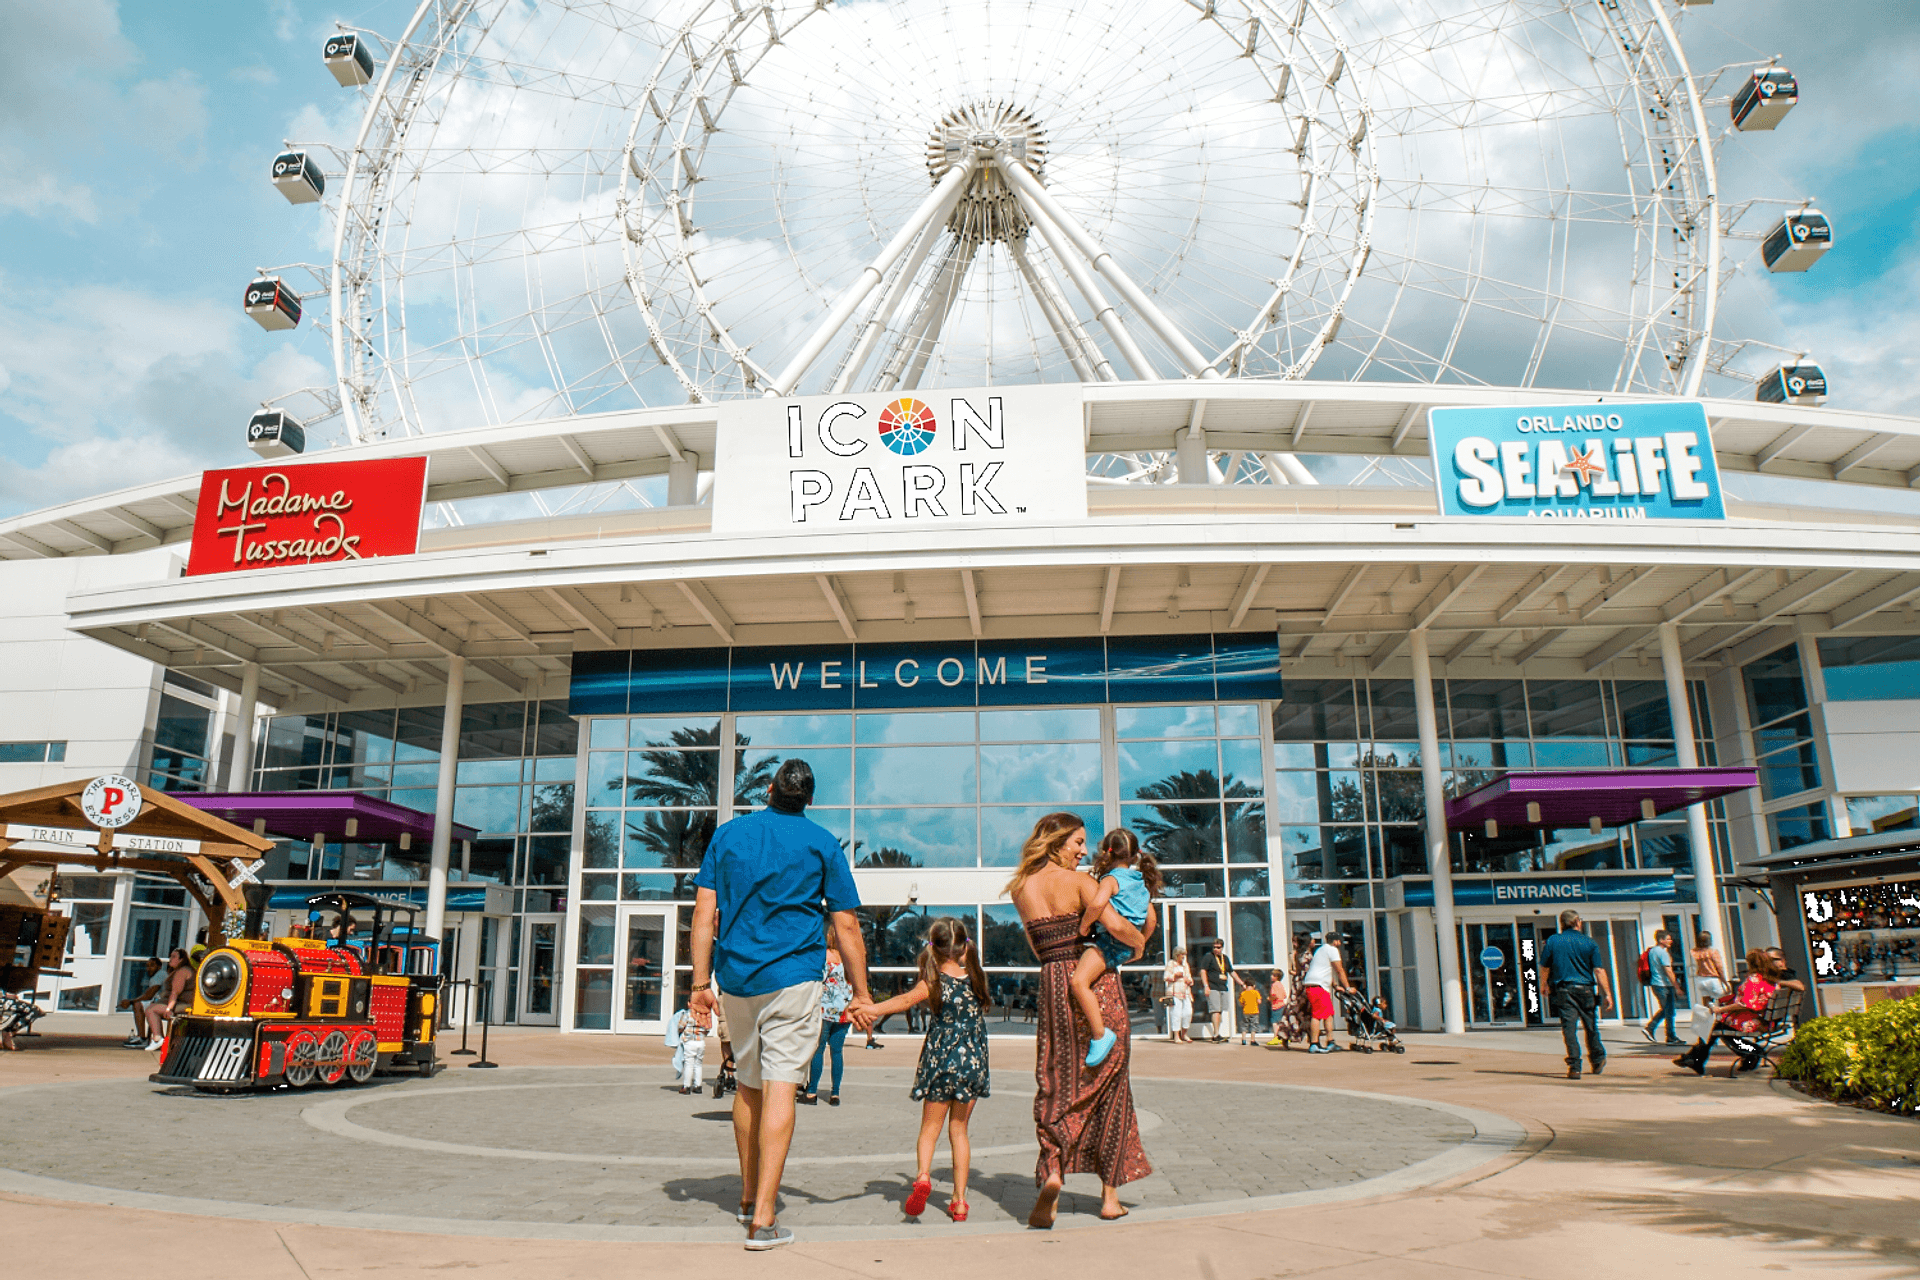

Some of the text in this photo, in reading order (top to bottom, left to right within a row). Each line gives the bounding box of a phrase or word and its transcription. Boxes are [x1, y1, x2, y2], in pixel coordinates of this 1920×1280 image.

[1516, 413, 1624, 433] ORLANDO
[1454, 435, 1580, 507] SEA
[217, 473, 353, 521] Madame
[790, 461, 1008, 523] PARK
[217, 513, 363, 564] Tussauds
[770, 655, 1048, 690] WELCOME
[86, 776, 139, 801] THE PEARL
[101, 786, 124, 815] P
[85, 804, 136, 826] EXPRESS
[31, 828, 184, 850] TRAIN STATION
[1496, 884, 1583, 899] ENTRANCE
